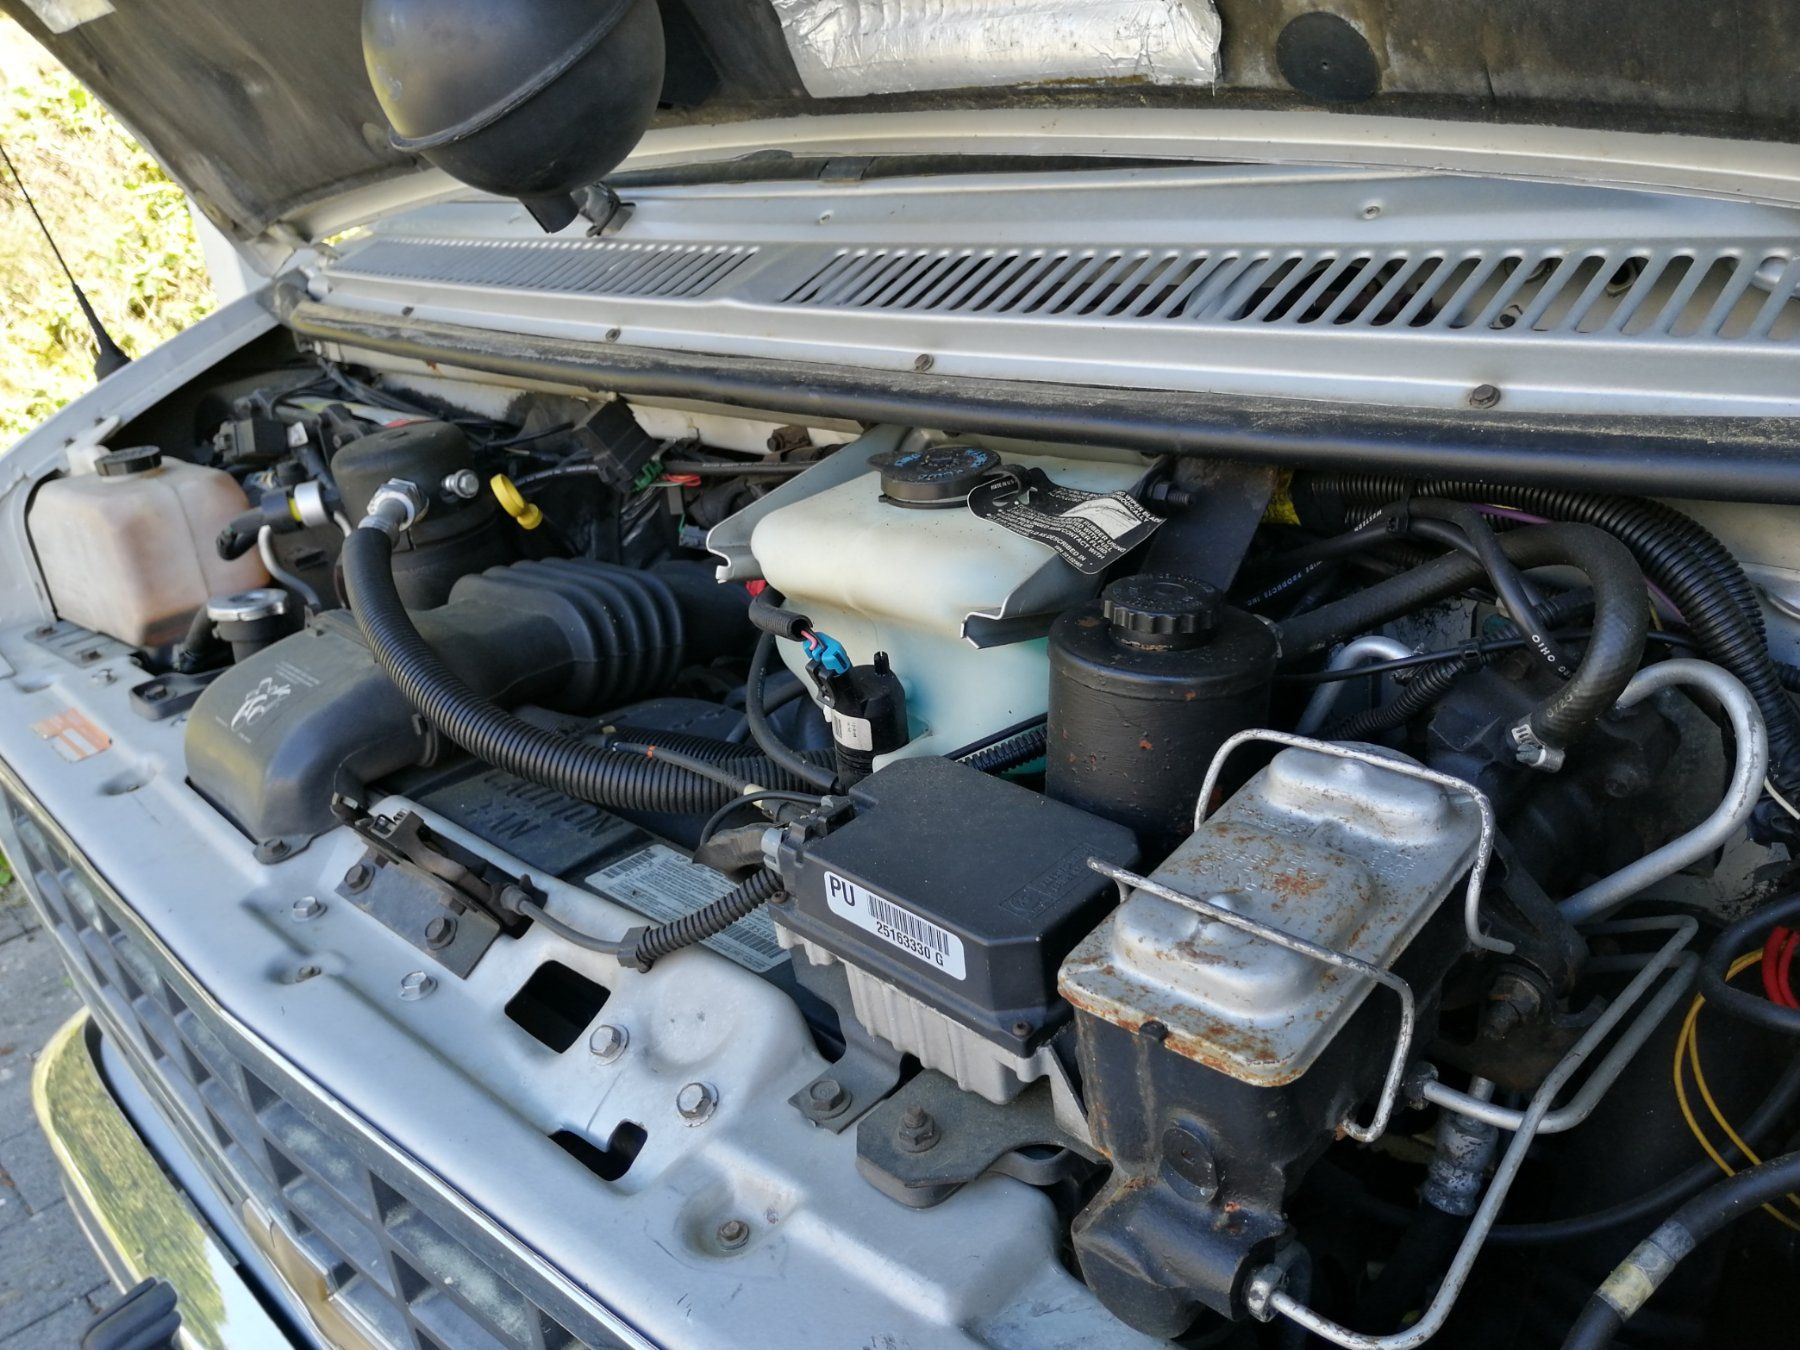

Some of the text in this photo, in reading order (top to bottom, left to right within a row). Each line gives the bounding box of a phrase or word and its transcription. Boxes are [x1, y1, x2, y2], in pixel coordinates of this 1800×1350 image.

[1125, 494, 1144, 512] WIPER
[1047, 534, 1079, 557] DESCRIBED
[1078, 553, 1087, 562] IN
[1060, 527, 1090, 549] CONTACT
[1088, 546, 1106, 560] WITH
[1083, 519, 1108, 541] RUBBER
[1106, 539, 1127, 553] USING
[1083, 526, 1114, 552] WITH FULL
[1531, 634, 1556, 662] OHIO
[829, 875, 856, 907] PU
[876, 921, 944, 967] 25163330 G
